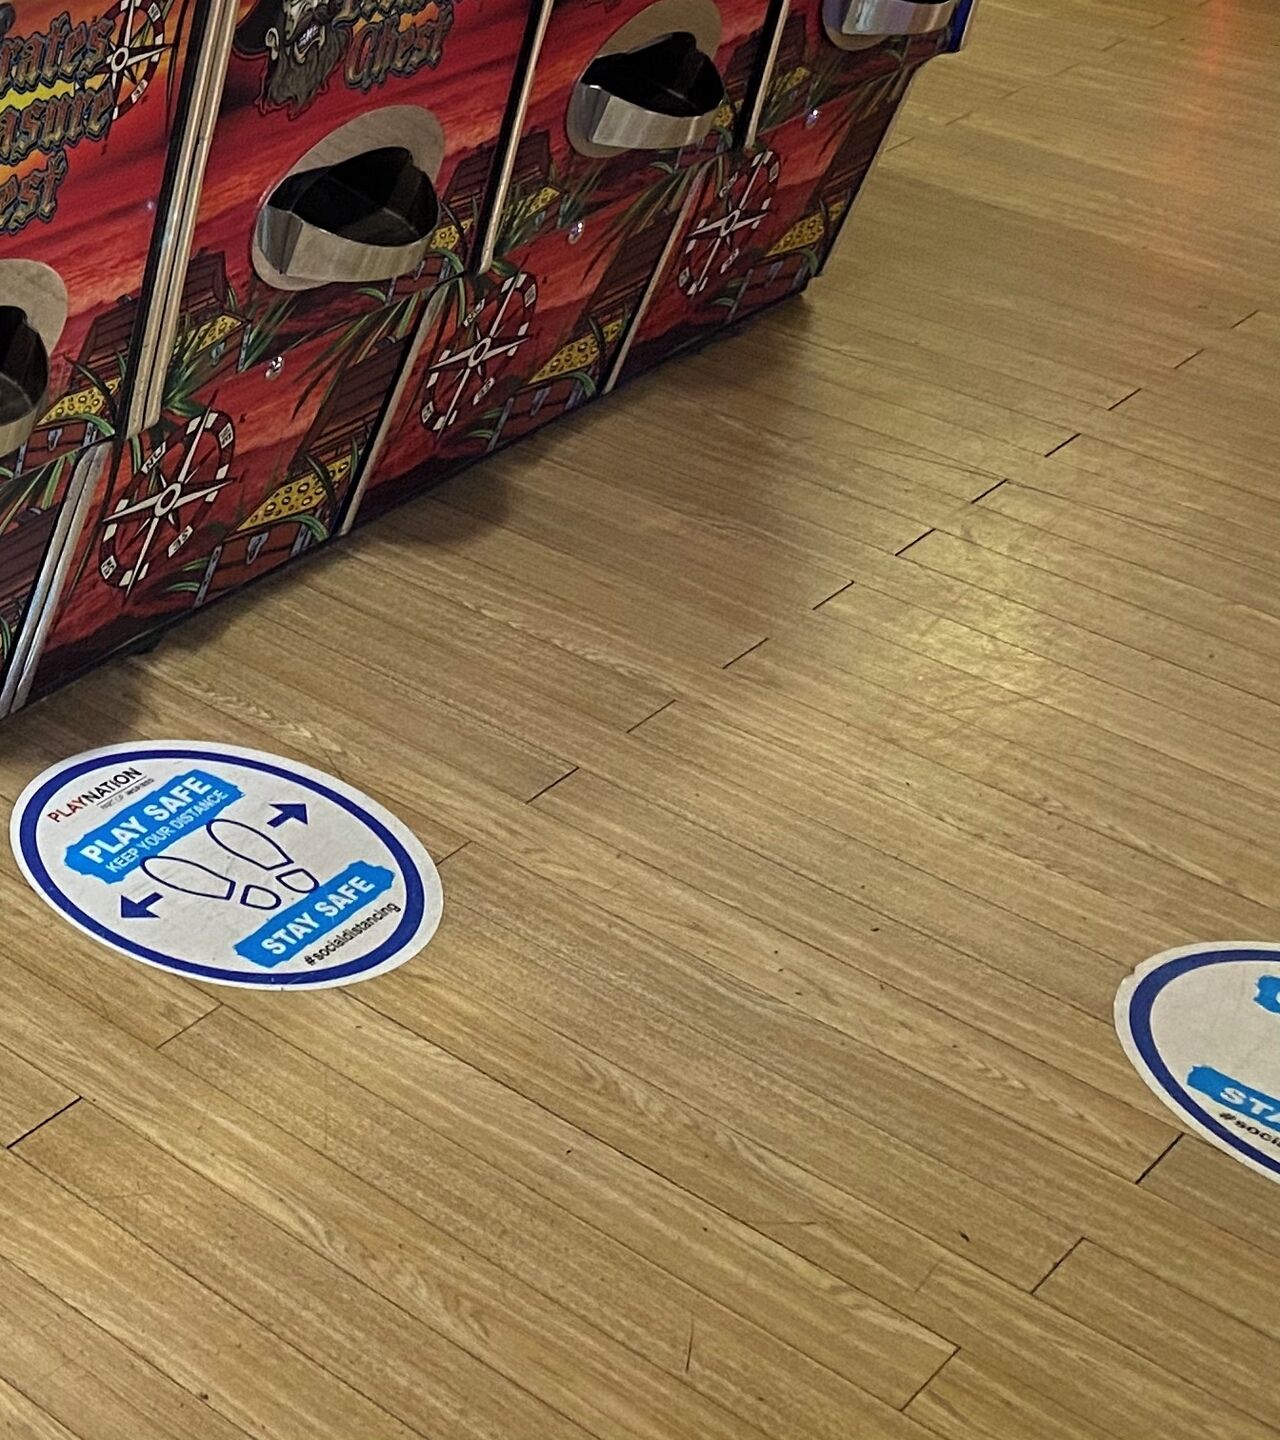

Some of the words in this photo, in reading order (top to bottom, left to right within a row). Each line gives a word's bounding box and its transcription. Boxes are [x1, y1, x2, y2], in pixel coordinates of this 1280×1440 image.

[344, 4, 454, 93] Chest
[46, 767, 142, 824] PLAYNATION
[79, 815, 150, 864] PLAY
[142, 774, 213, 823] SAFE
[105, 849, 140, 873] KEEP
[139, 824, 172, 852] YOUR
[170, 788, 229, 831] DISTANCE
[261, 911, 321, 956] STAY
[318, 875, 376, 919] SAFE
[305, 901, 401, 966] #socialdistancing
